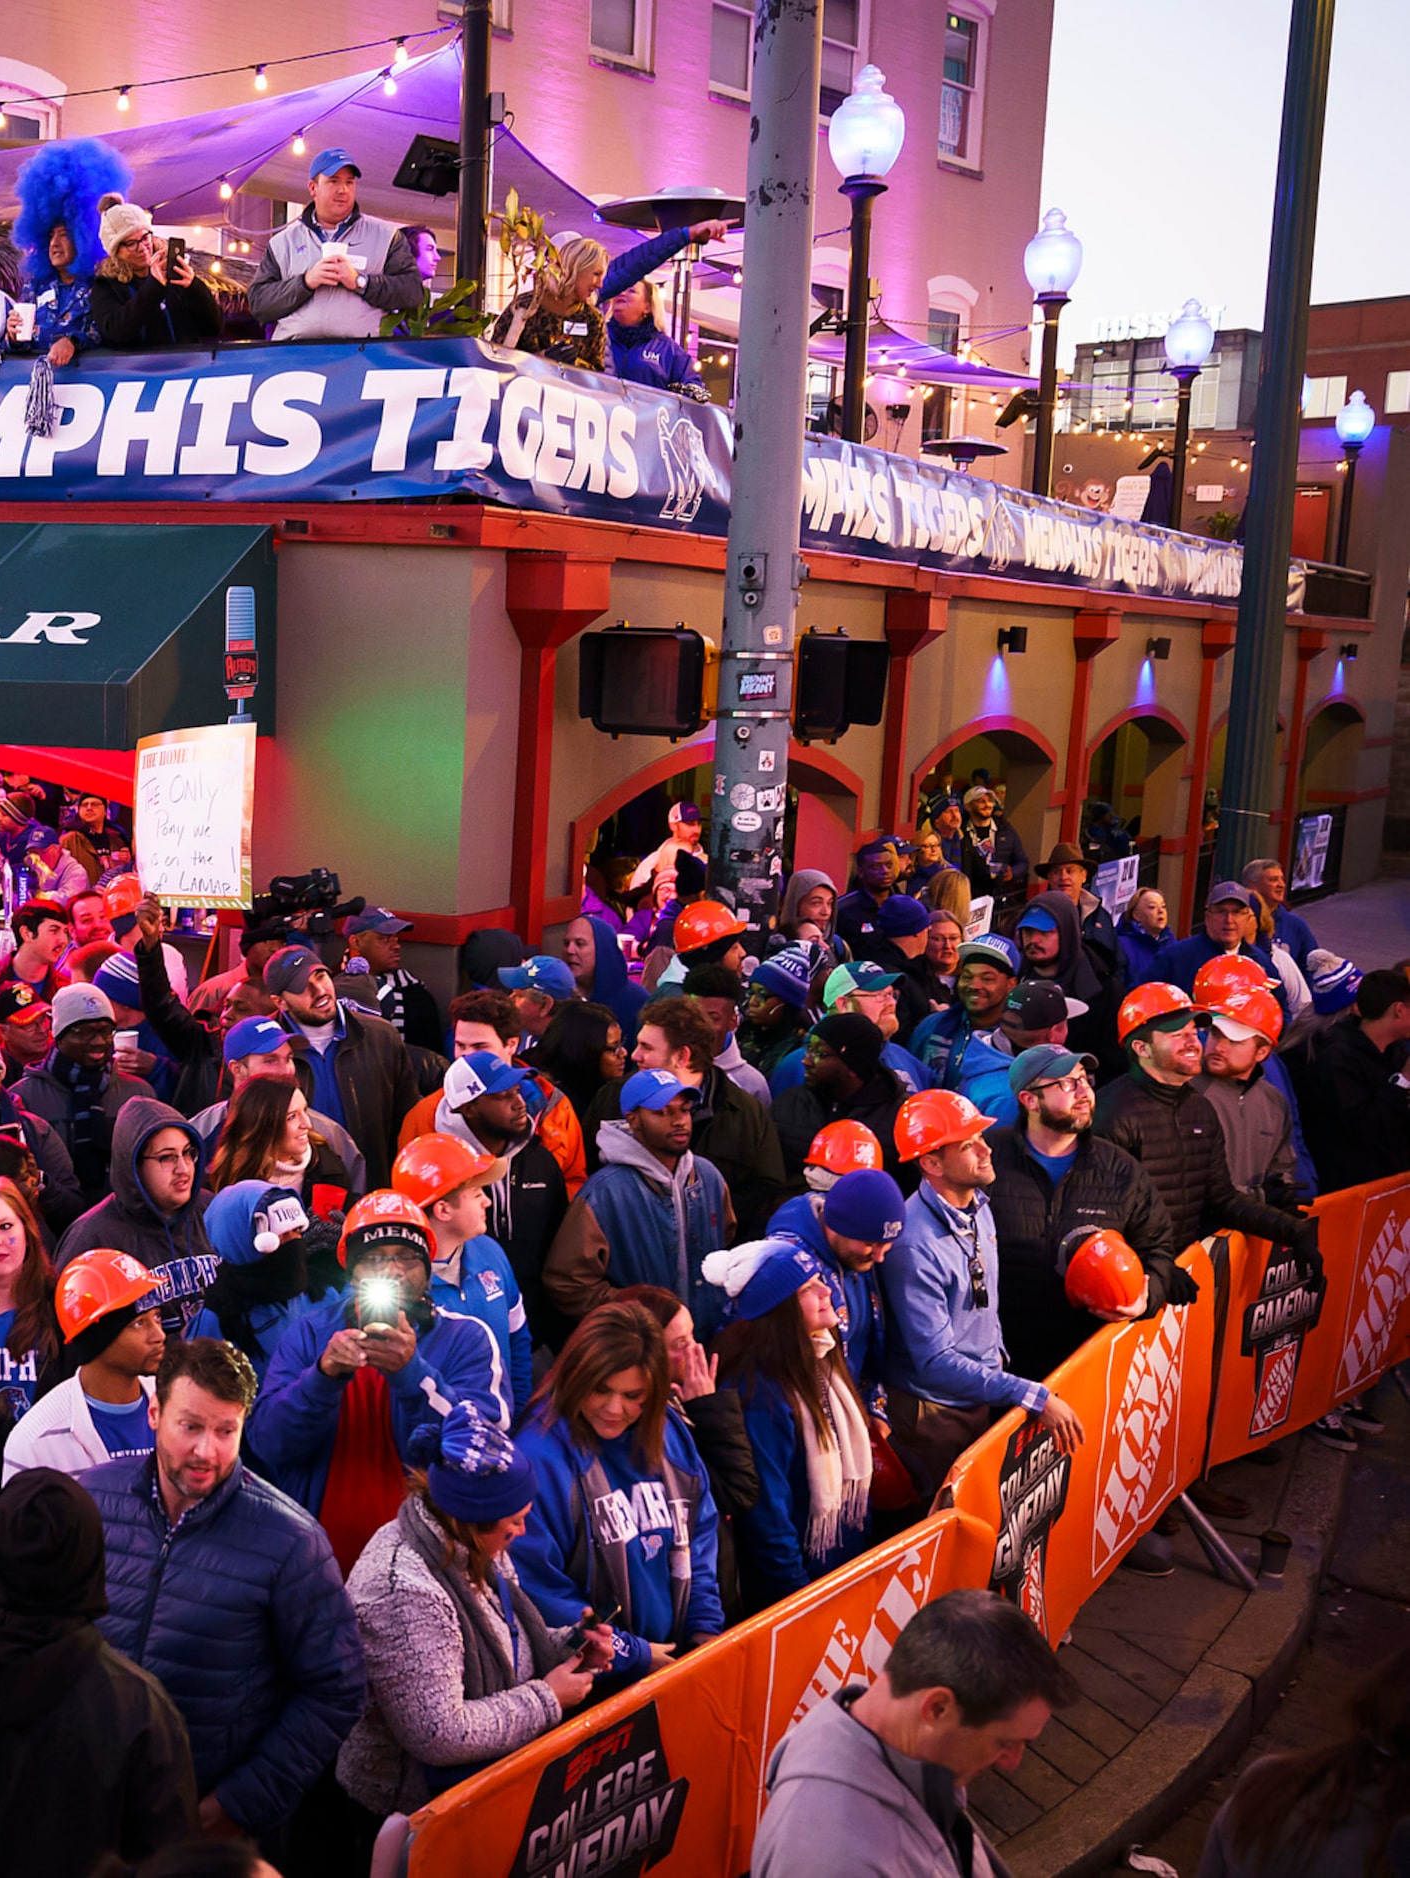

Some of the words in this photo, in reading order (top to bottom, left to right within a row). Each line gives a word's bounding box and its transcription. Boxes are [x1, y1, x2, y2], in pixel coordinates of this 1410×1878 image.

[362, 366, 637, 499] TIGERS
[802, 445, 890, 544] MPHIS
[895, 477, 984, 559] TIGERS
[1023, 510, 1101, 580] MEMPHIS
[1104, 530, 1159, 588] TIGERS
[1250, 1287, 1319, 1340] GAMEDAY
[564, 1723, 634, 1793] ESPN
[526, 1750, 656, 1873] COLLEGE
